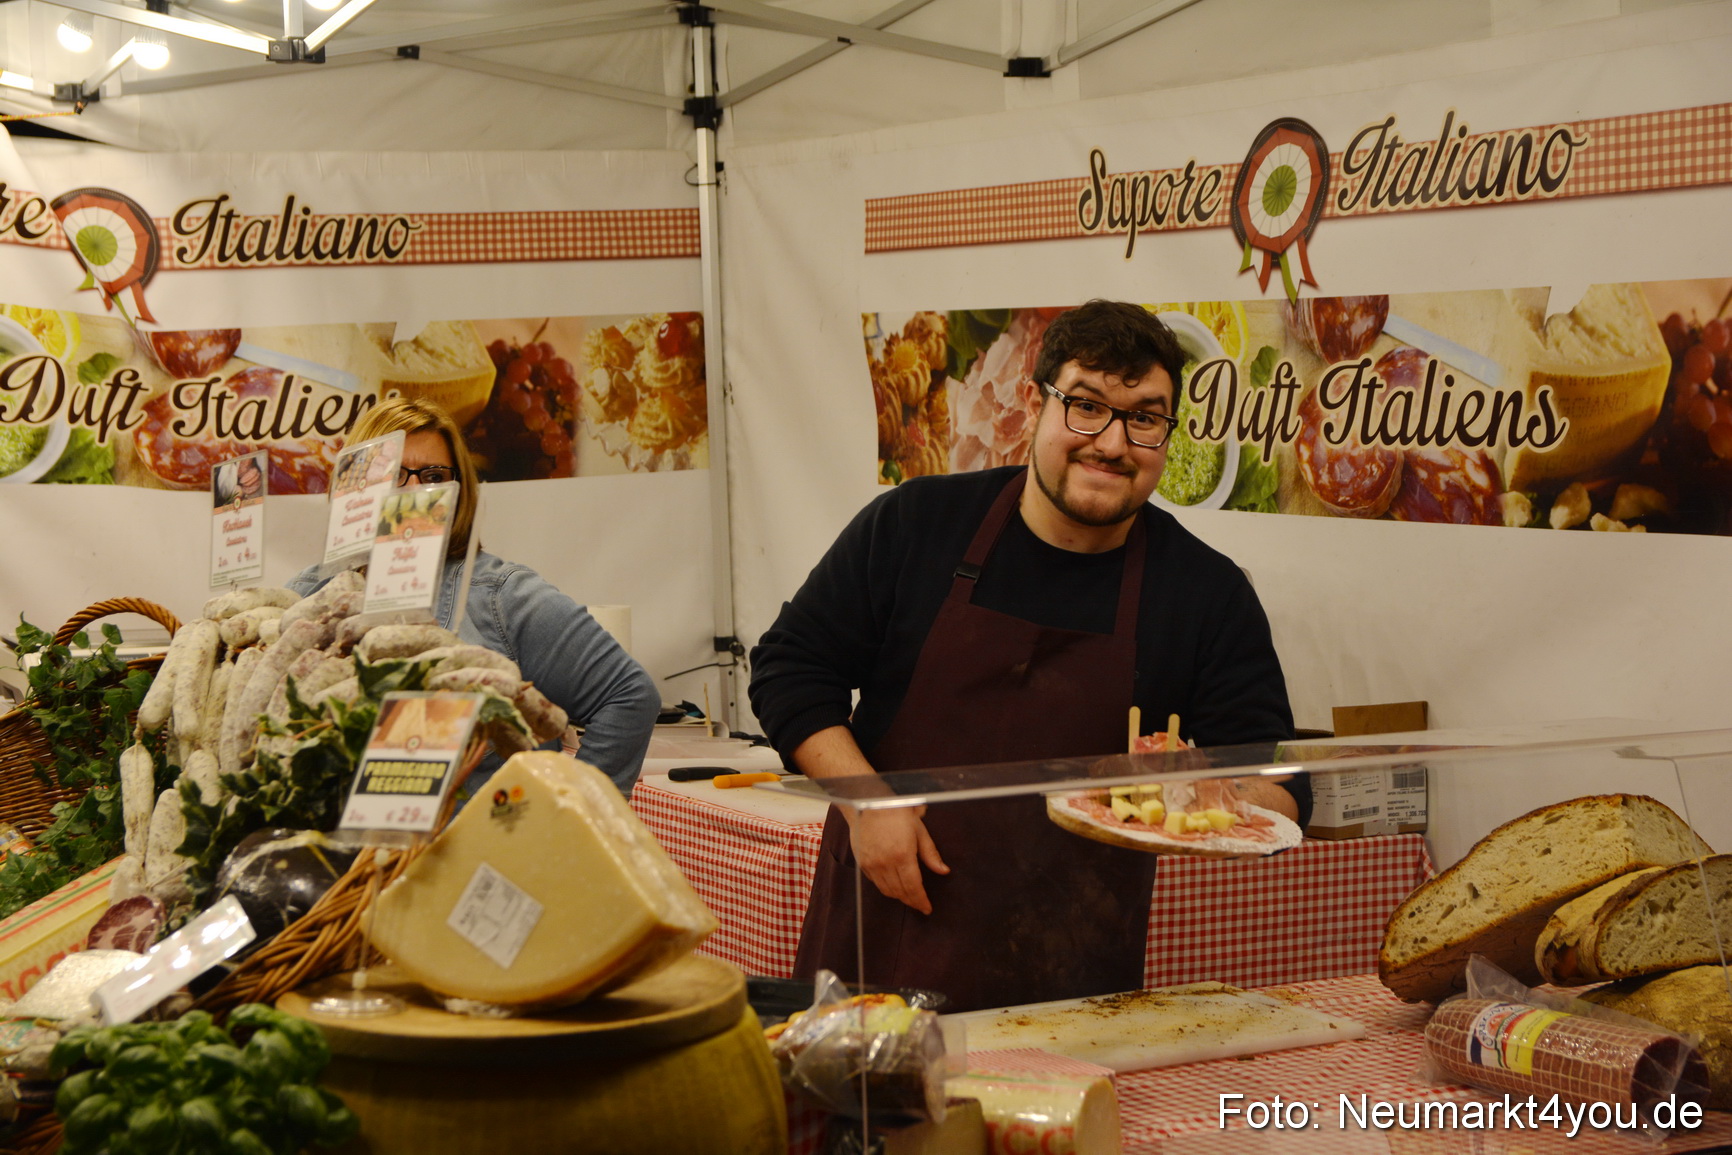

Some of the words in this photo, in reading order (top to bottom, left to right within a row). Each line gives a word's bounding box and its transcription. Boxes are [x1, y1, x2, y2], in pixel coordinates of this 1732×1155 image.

[172, 194, 422, 264] Italiano
[1079, 149, 1222, 259] Sapore
[1337, 109, 1588, 212] Italiano
[0, 356, 150, 444] Duft
[172, 374, 399, 441] Italien
[1188, 359, 1303, 463] Duft
[1320, 359, 1567, 448] Italiens
